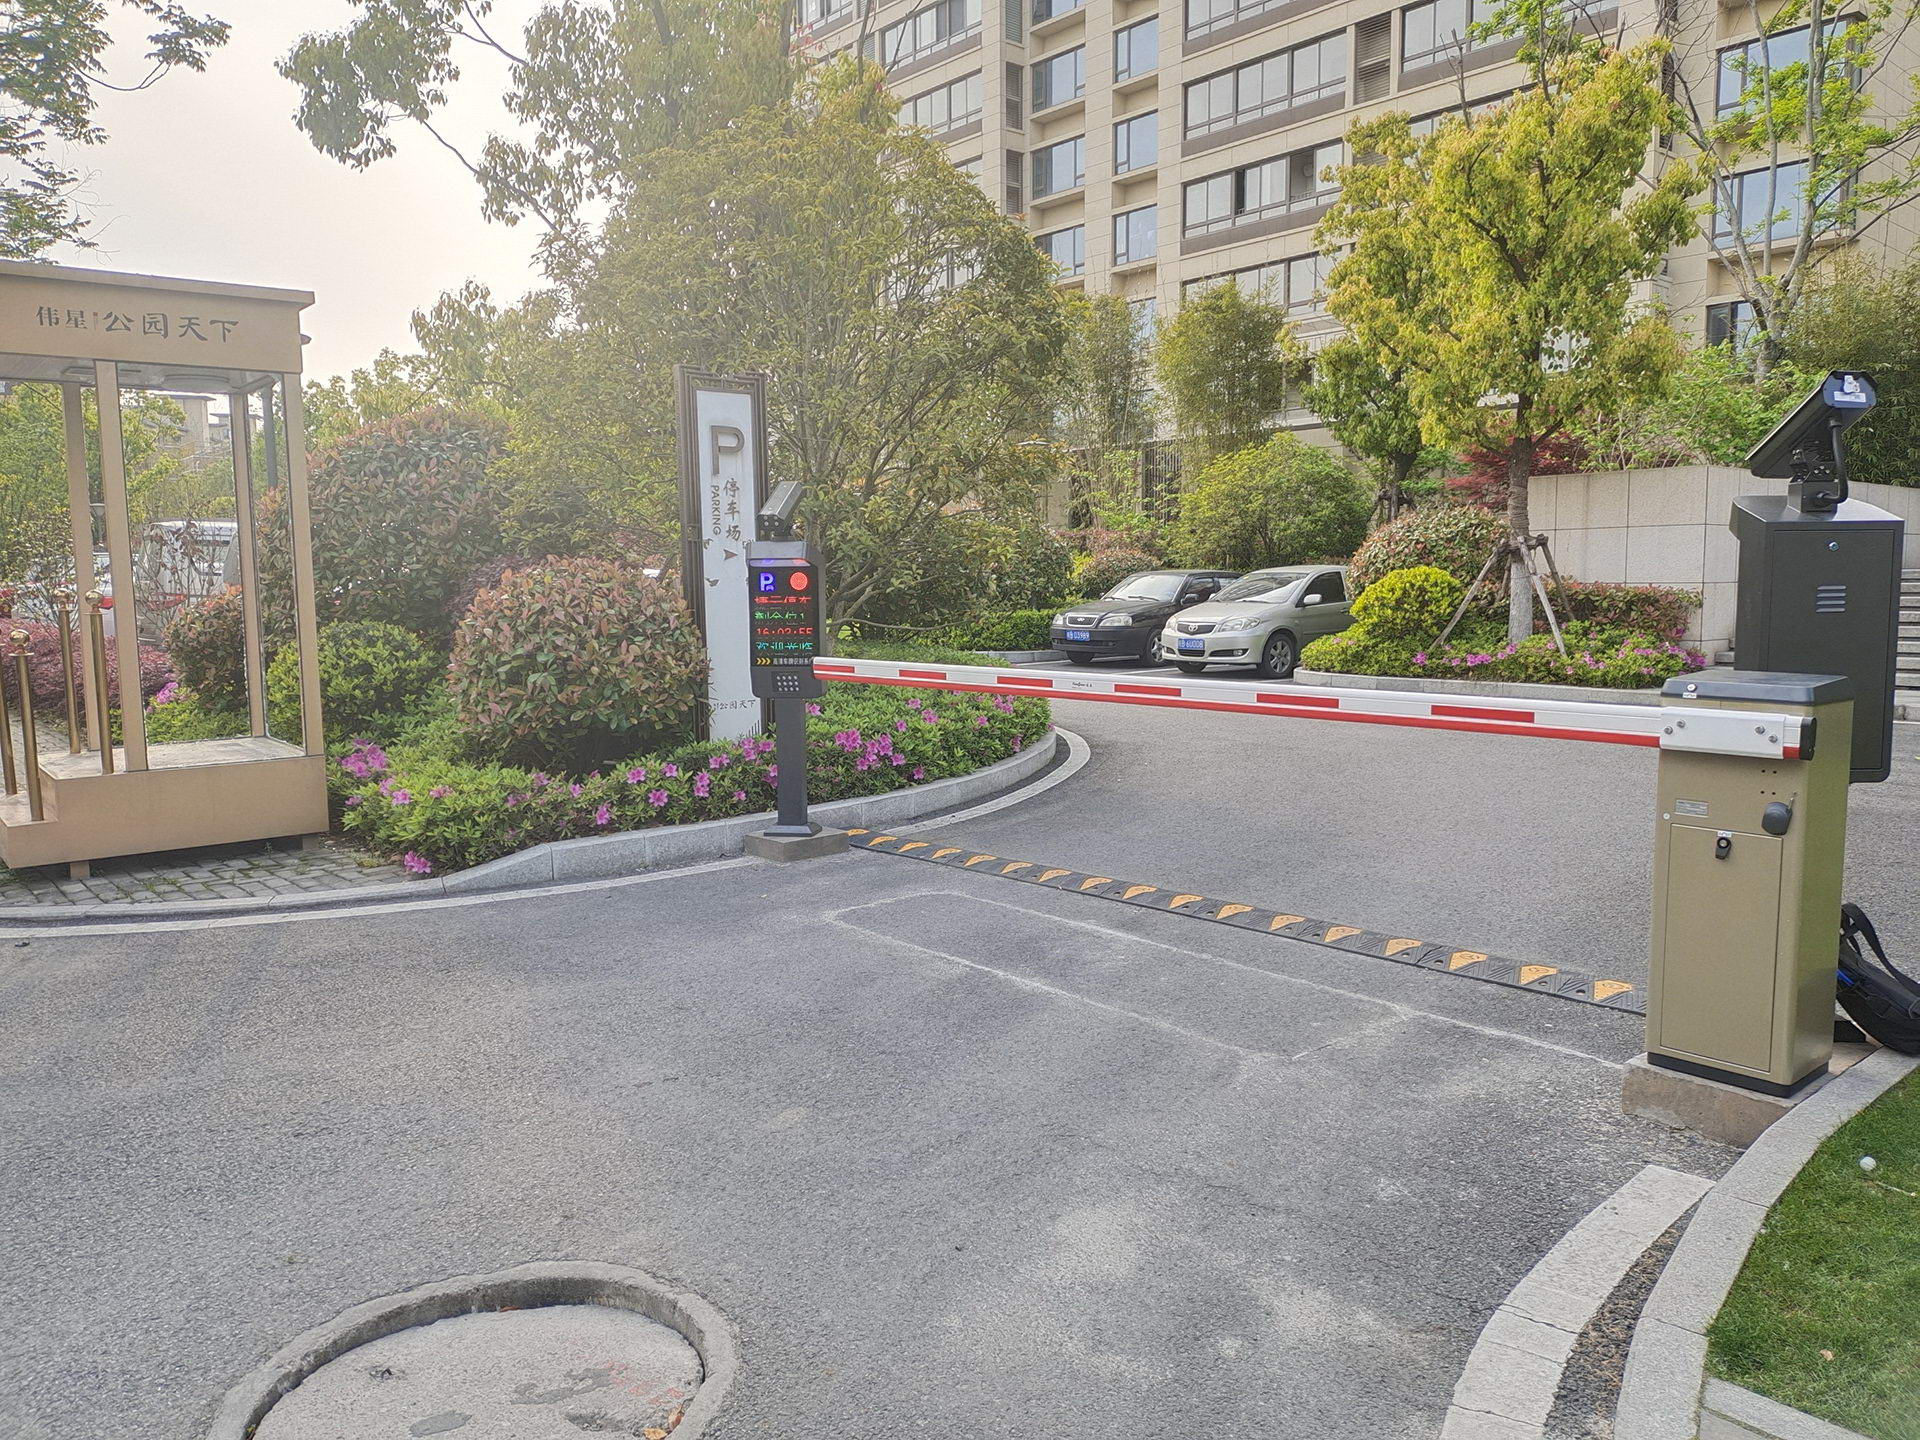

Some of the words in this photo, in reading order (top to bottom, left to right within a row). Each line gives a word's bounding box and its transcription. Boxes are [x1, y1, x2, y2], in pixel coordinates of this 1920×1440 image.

[36, 305, 88, 330] 伟星
[102, 311, 240, 343] 公园天下
[710, 425, 745, 475] P
[711, 485, 722, 535] PARKING
[723, 478, 741, 542] 停车场
[760, 572, 774, 591] P
